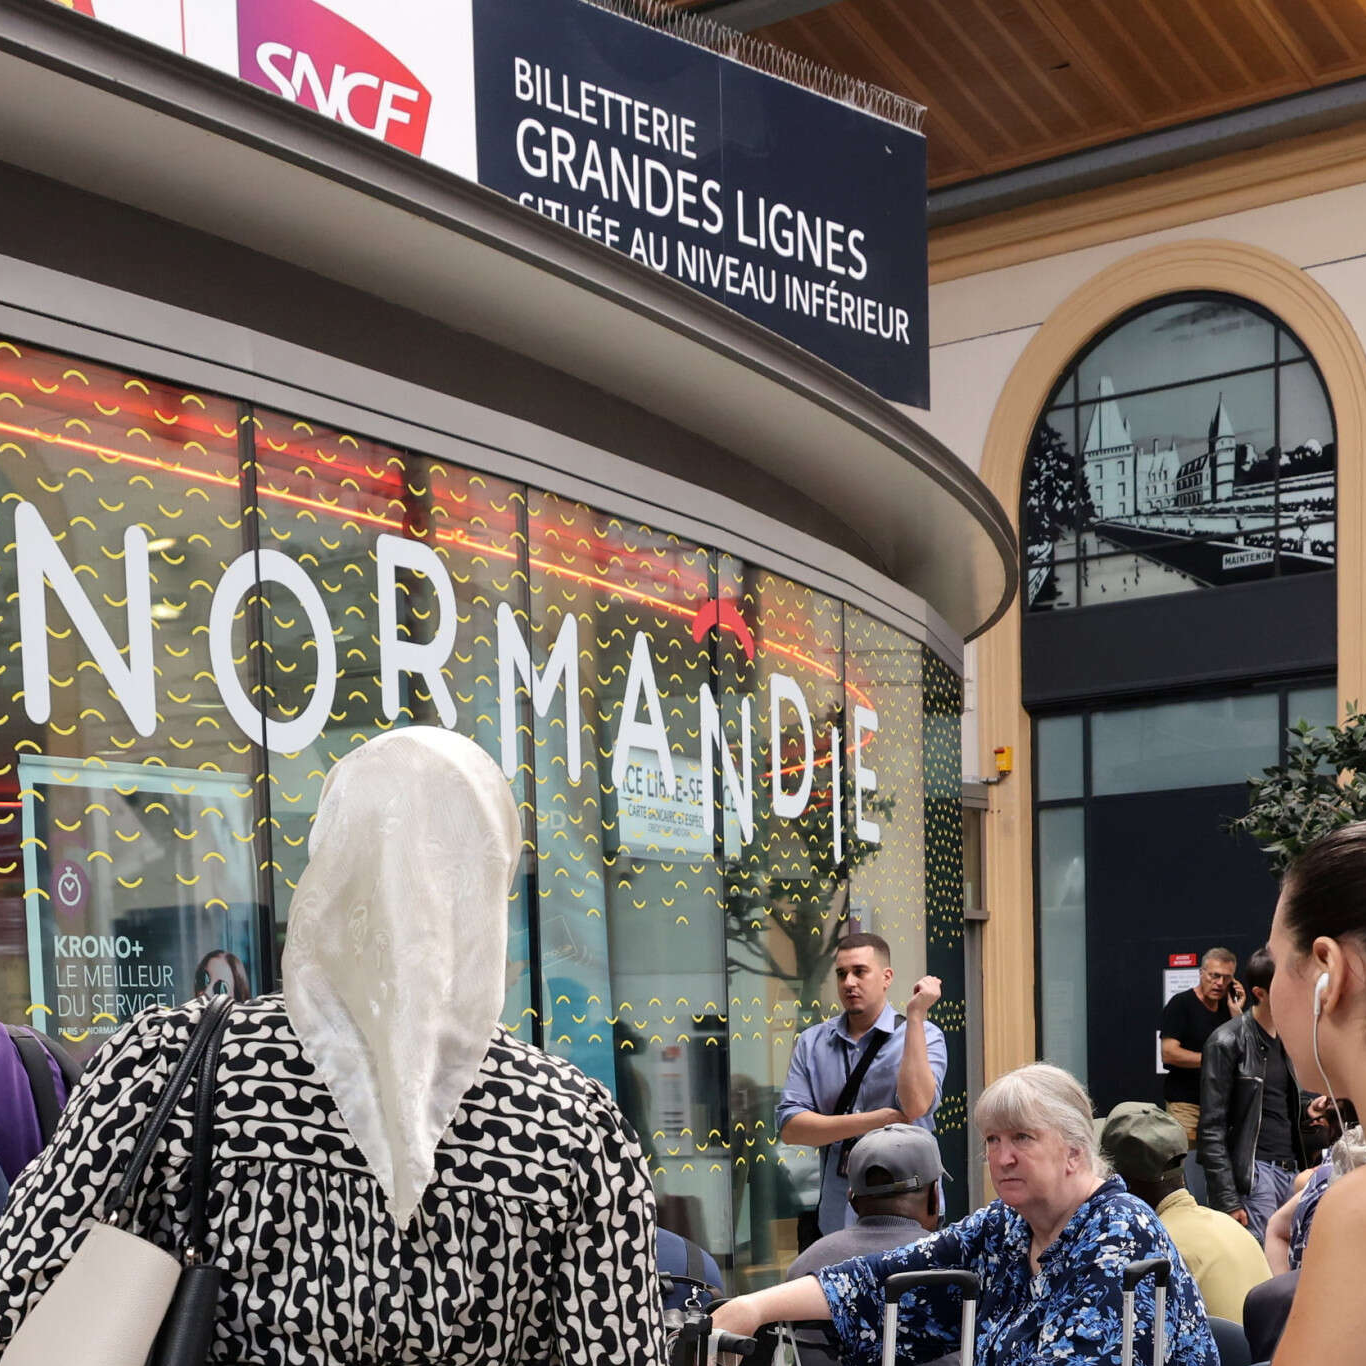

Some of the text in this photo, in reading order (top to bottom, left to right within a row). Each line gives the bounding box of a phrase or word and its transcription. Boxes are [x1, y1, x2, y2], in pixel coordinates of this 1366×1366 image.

[256, 42, 419, 141] SNCF
[514, 56, 697, 160] BILLETTERIE
[516, 117, 868, 281] GRANDES LIGNES
[629, 227, 668, 272] AU
[677, 240, 777, 305] NIVEAU
[785, 273, 910, 345] INFÉRIEUR
[14, 501, 881, 863] NORMANDIE
[53, 935, 144, 959] KRONO+
[55, 965, 175, 988] LE MEILLEUR
[57, 994, 85, 1018] DU
